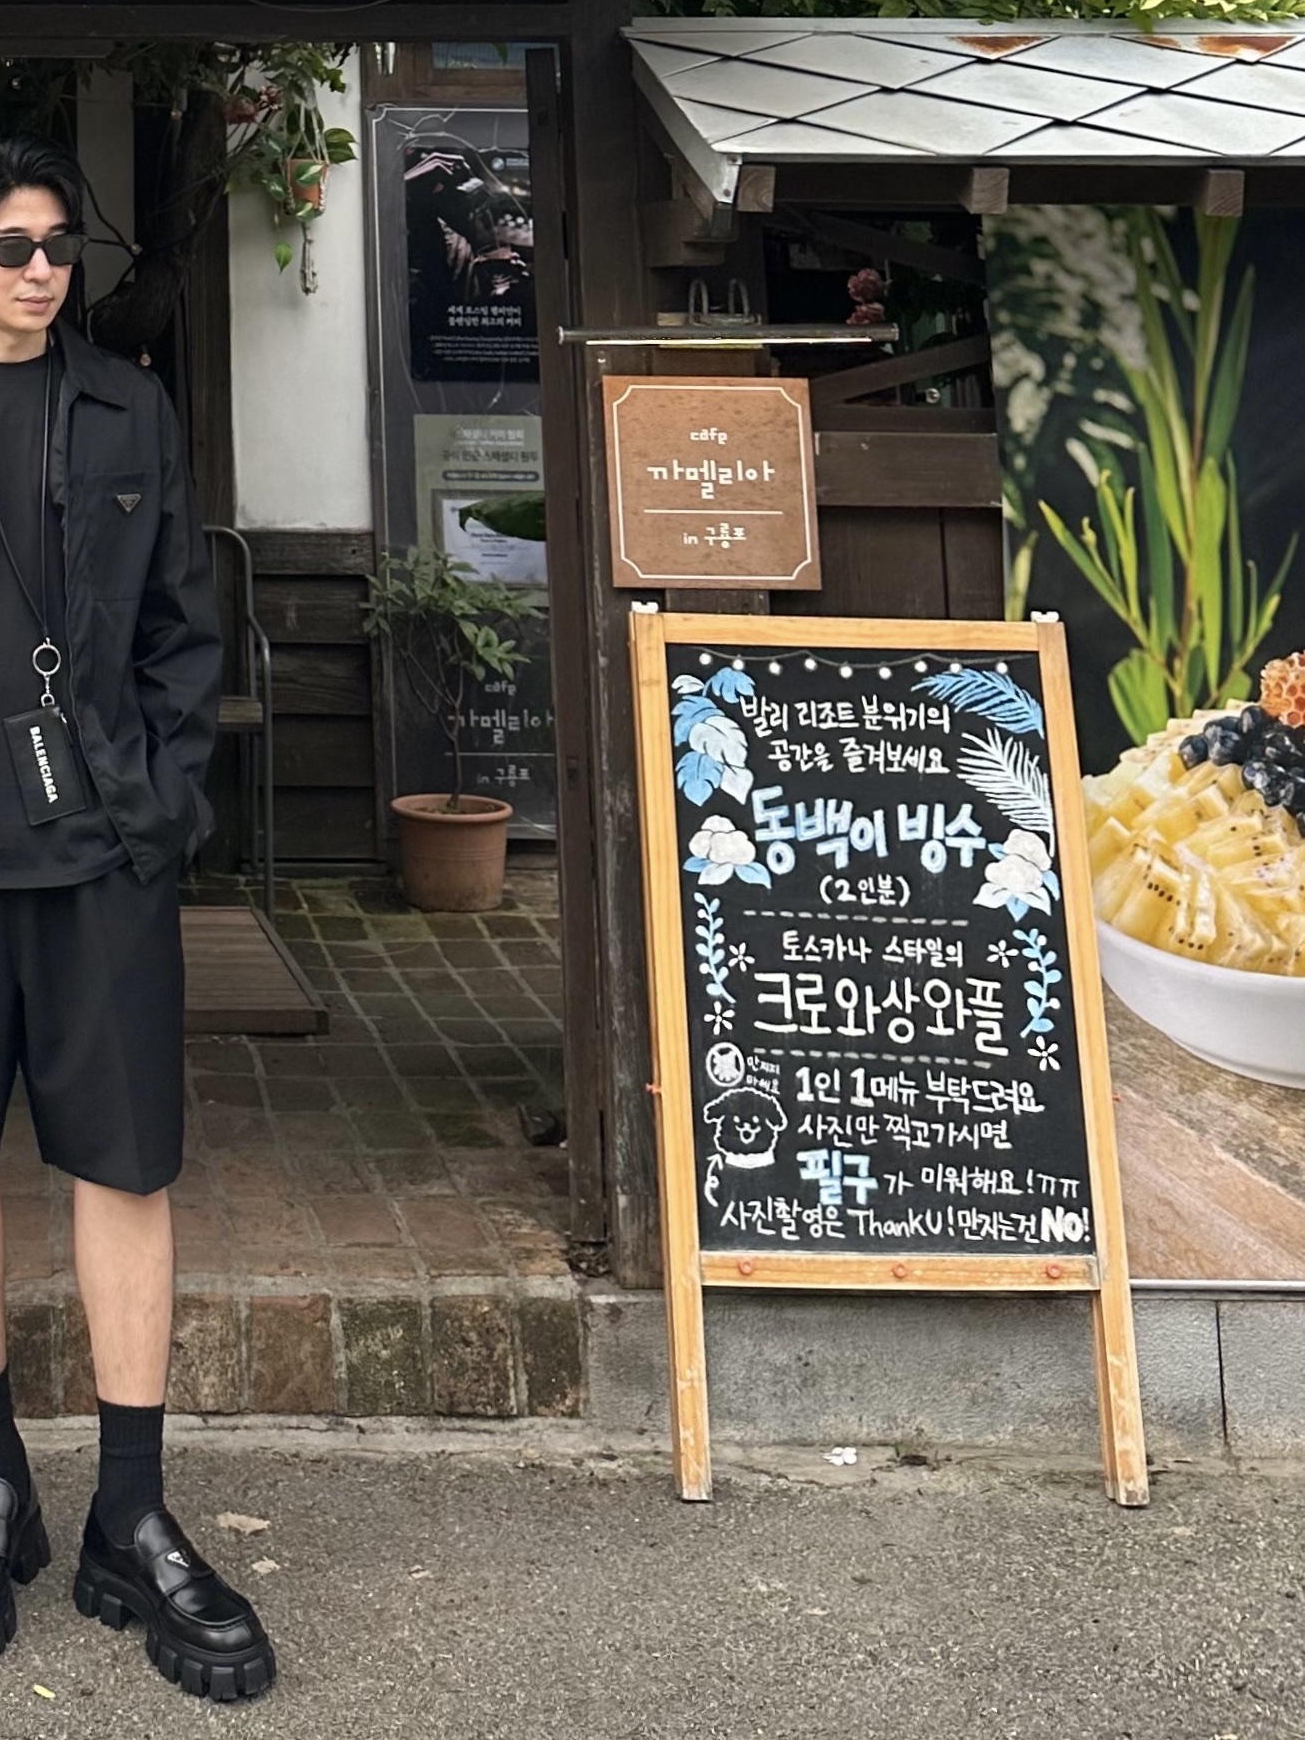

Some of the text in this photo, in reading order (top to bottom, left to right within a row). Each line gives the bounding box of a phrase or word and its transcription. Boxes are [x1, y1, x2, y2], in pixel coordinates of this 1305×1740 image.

[690, 427, 728, 444] cafe
[647, 460, 775, 500] 까멜리아
[683, 523, 747, 549] in 구룡포
[484, 681, 517, 696] cafe
[740, 694, 951, 738] 발리 리조트 분위기의
[29, 726, 60, 804] BALENCIAGA
[767, 736, 951, 774] 공간을 즐겨보세요
[751, 785, 987, 875] 동백이 빙수
[782, 930, 964, 968] 토스카나 스타일의
[795, 1067, 1046, 1115] 1인 1메뉴 부탁드려요
[797, 1113, 881, 1148] 사진만
[796, 1148, 879, 1206] 필구
[1040, 1205, 1092, 1243] NO!
